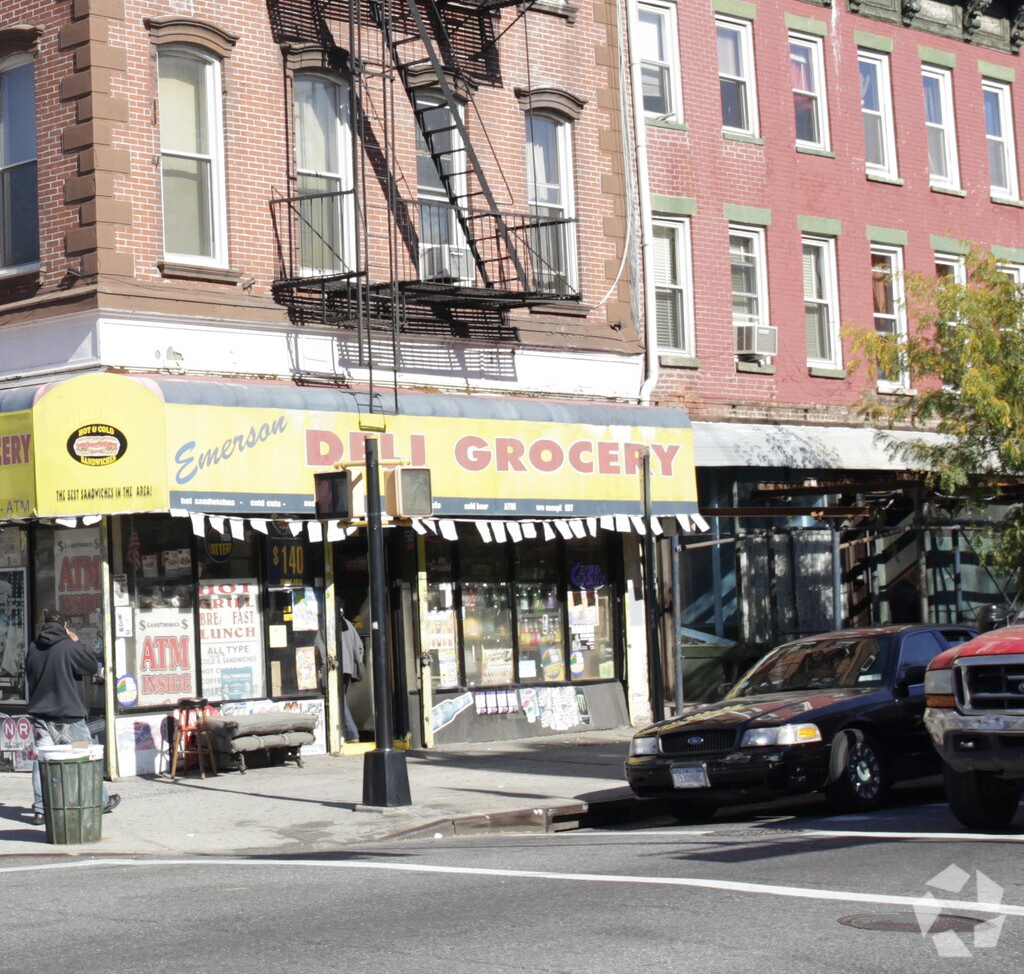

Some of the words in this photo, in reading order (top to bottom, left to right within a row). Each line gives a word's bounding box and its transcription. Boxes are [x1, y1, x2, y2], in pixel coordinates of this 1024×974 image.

[78, 426, 91, 436] HOT
[98, 426, 115, 435] COLD
[175, 415, 288, 485] Emerson
[305, 429, 426, 466] DELI
[454, 435, 680, 476] GROCERY
[80, 455, 116, 466] SANDWICHES
[56, 490, 66, 501] THE
[67, 489, 82, 501] BEST
[81, 487, 113, 499] SANDWICHES
[115, 487, 121, 498] IN
[123, 486, 133, 497] THE
[6, 500, 30, 514] ATM
[180, 497, 192, 505] hot
[194, 498, 236, 507] sandwiches
[250, 499, 265, 507] cold
[266, 499, 281, 508] cuts
[58, 555, 102, 592] ATM
[198, 583, 253, 595] HOT
[200, 627, 256, 639] LUNCH
[140, 635, 190, 671] ATM
[207, 646, 224, 655] ALL
[226, 645, 249, 654] TYPE
[223, 656, 257, 664] SANDWICHES
[141, 673, 192, 695] INSIDE
